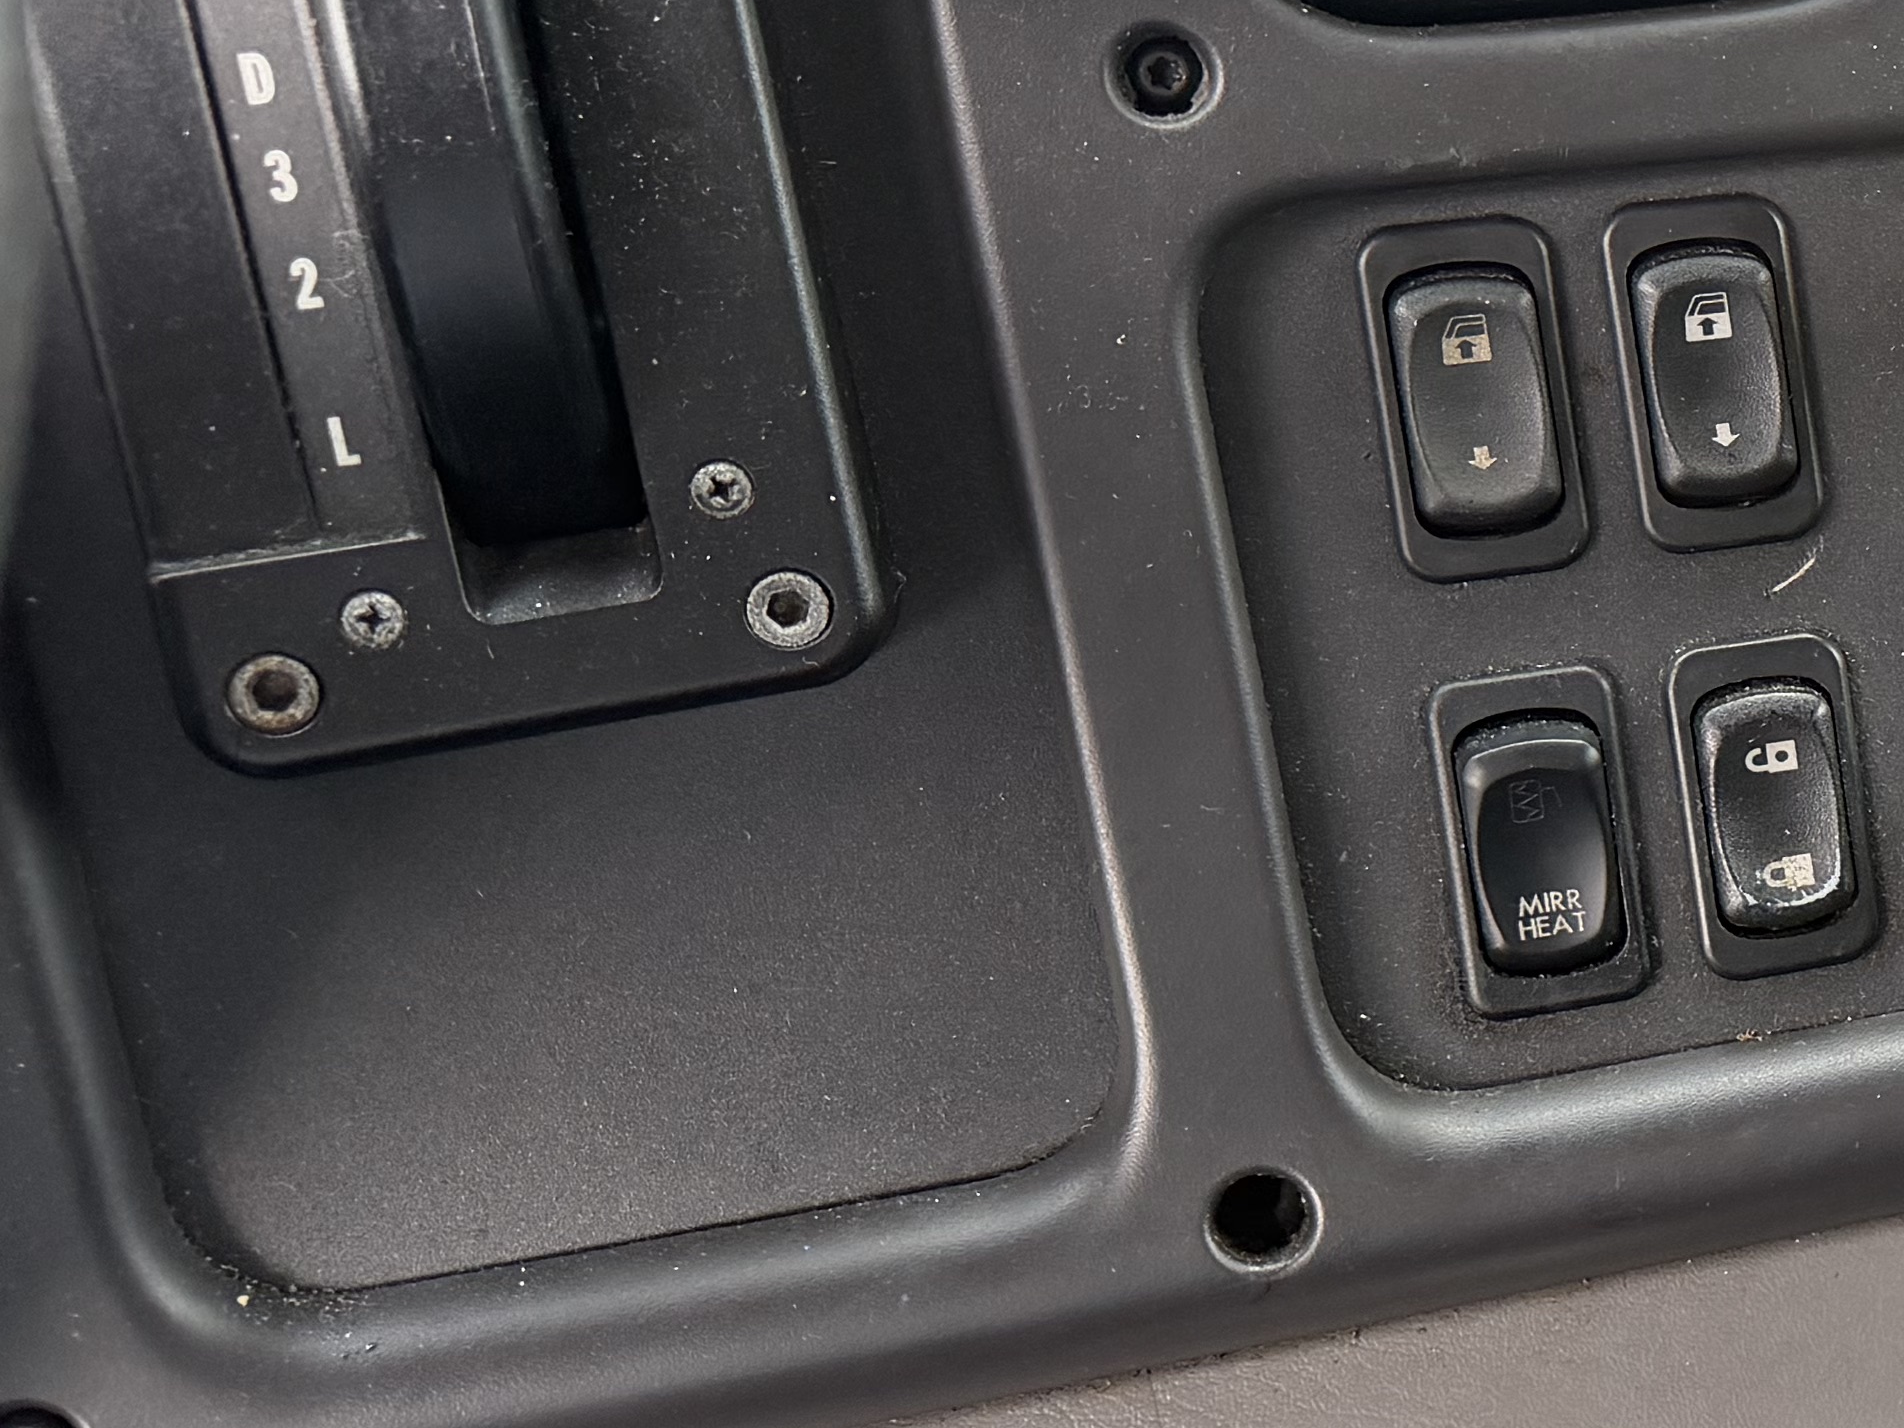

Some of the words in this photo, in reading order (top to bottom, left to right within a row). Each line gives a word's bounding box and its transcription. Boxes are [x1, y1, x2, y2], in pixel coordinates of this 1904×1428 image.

[236, 52, 276, 105] D
[262, 149, 299, 203] 3
[288, 257, 325, 311] 2
[326, 415, 362, 467] L
[1518, 911, 1586, 940] HEAT
[1519, 889, 1582, 917] MIRR
